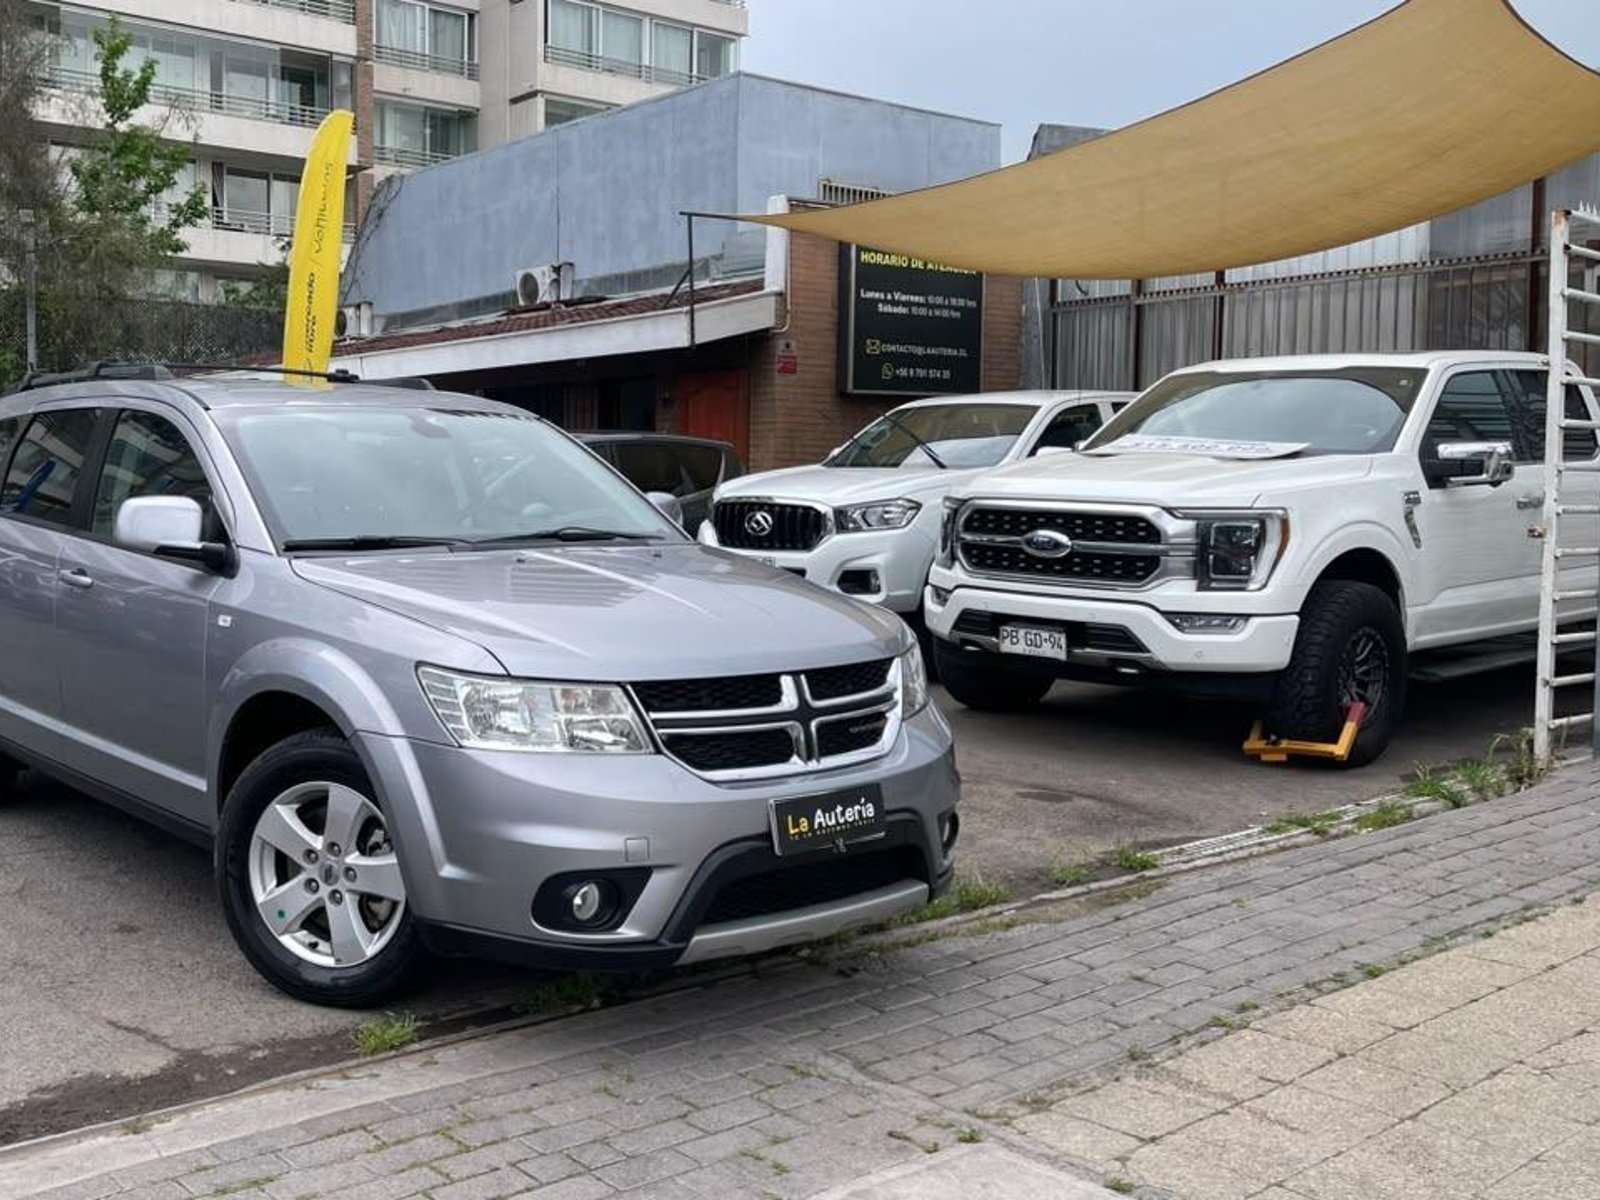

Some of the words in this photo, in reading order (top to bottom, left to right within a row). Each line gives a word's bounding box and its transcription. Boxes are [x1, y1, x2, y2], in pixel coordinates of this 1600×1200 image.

[861, 250, 908, 267] HORARIO
[1002, 628, 1020, 646] PB
[788, 815, 809, 835] La
[814, 797, 875, 829] Autería
